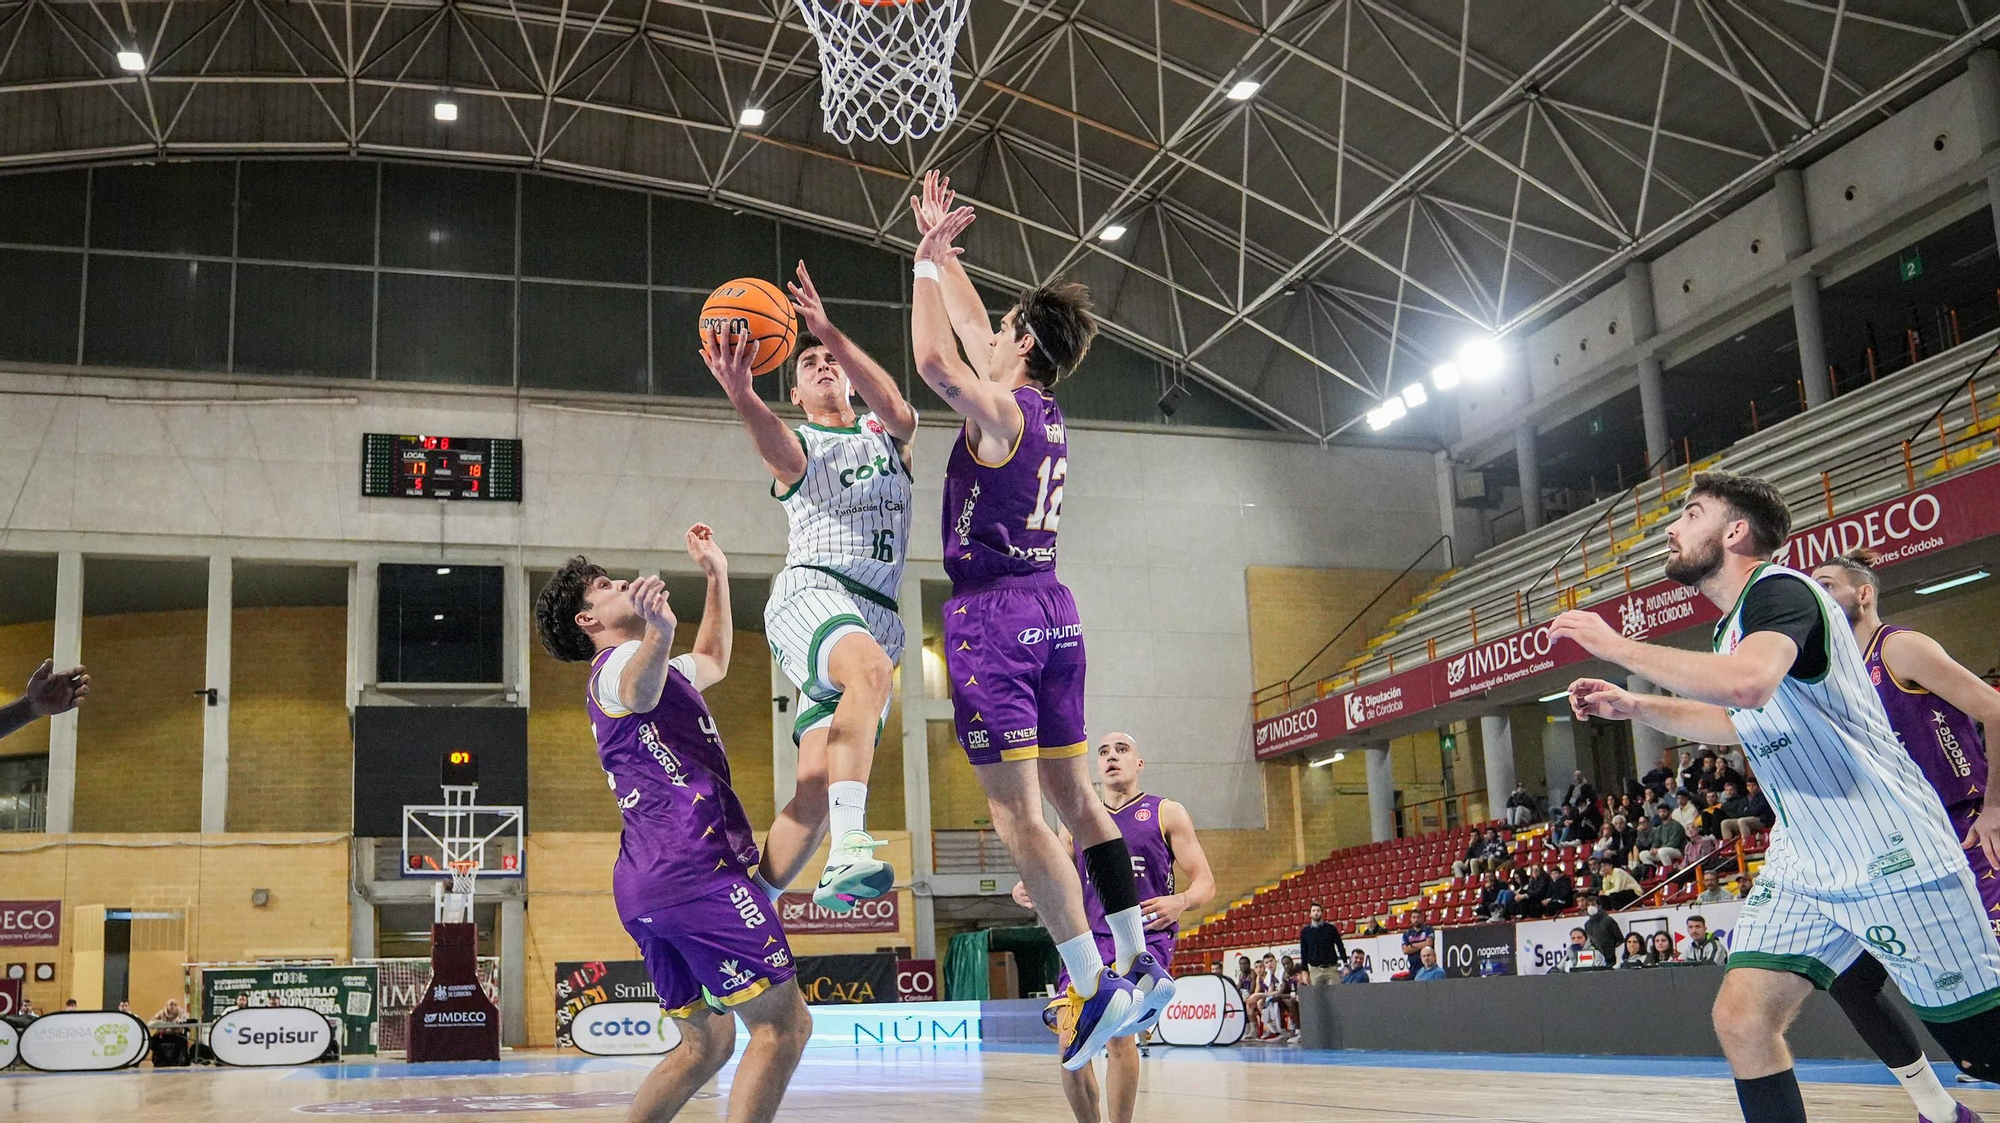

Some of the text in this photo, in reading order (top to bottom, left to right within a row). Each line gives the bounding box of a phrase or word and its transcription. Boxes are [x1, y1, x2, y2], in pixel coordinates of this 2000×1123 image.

[1907, 262, 1916, 276] 2
[413, 462, 426, 475] 17
[469, 464, 482, 477] 18
[414, 478, 423, 490] 5
[472, 480, 479, 492] 3
[1025, 455, 1068, 532] 12
[835, 502, 878, 516] Fundación
[1795, 494, 1941, 570] IMDECO
[872, 529, 895, 563] 16
[1900, 535, 1945, 557] Córdoba
[1646, 585, 1700, 612] AYUNTAMIENTO
[1647, 601, 1694, 628] DE CÓRDOBA
[1468, 626, 1552, 679] IMDECO
[1470, 678, 1496, 692] Municipal
[1495, 675, 1503, 684] de
[1503, 667, 1529, 682] Deportes
[1529, 660, 1555, 674] Córdoba
[1365, 686, 1402, 707] Diputación
[1366, 700, 1403, 720] de Córdoba
[1268, 708, 1318, 742] IMDECO
[968, 729, 989, 745] CBC
[1444, 737, 1451, 749] A
[638, 723, 676, 775] aspasia
[1939, 726, 1971, 777] aspasia
[0, 909, 55, 930] ECO
[1447, 943, 1473, 967] no
[1477, 944, 1510, 958] nogomet
[285, 986, 339, 998] ORGULLO
[438, 1011, 487, 1022] IMDECO
[1166, 1001, 1217, 1020] CÓRDOBA
[589, 1017, 651, 1037] coto
[237, 1026, 319, 1050] Sepisur
